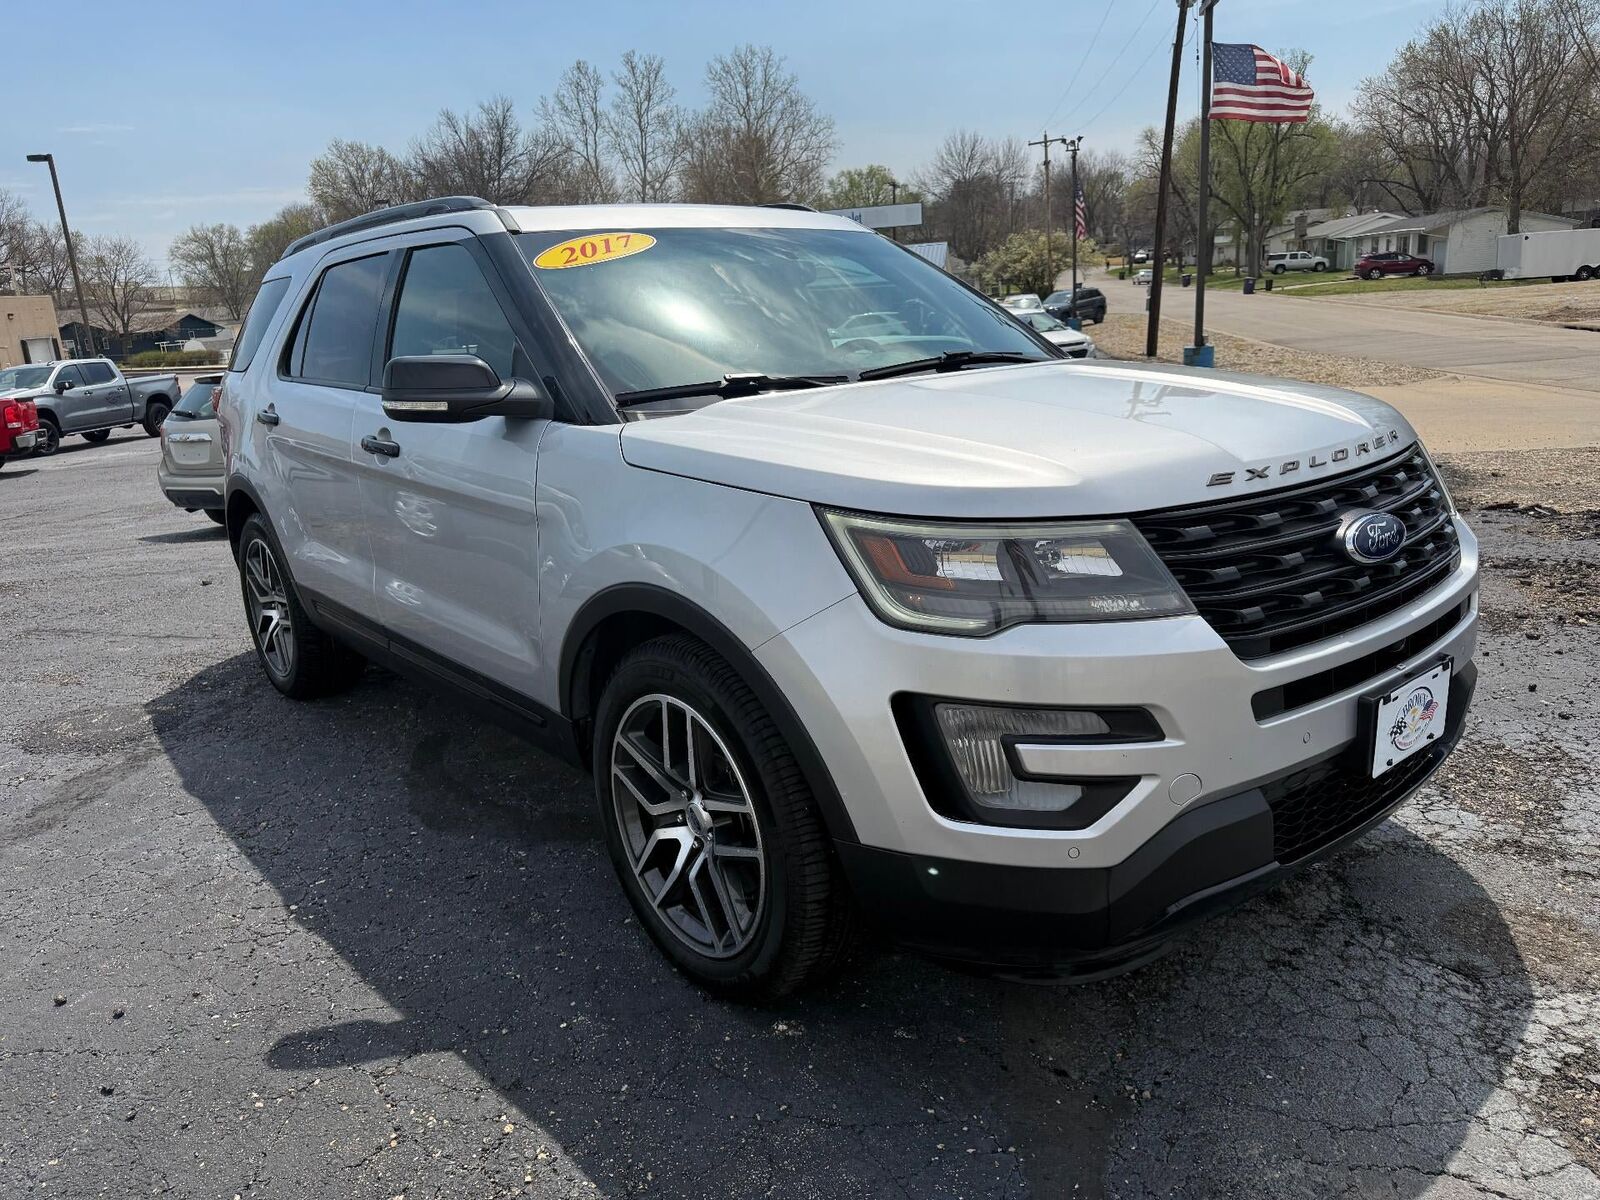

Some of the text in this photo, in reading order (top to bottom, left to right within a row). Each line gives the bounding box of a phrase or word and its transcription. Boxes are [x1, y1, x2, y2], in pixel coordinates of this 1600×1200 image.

[560, 234, 632, 265] 2017
[1206, 429, 1400, 487] EXPLORER
[1366, 521, 1400, 553] Ford
